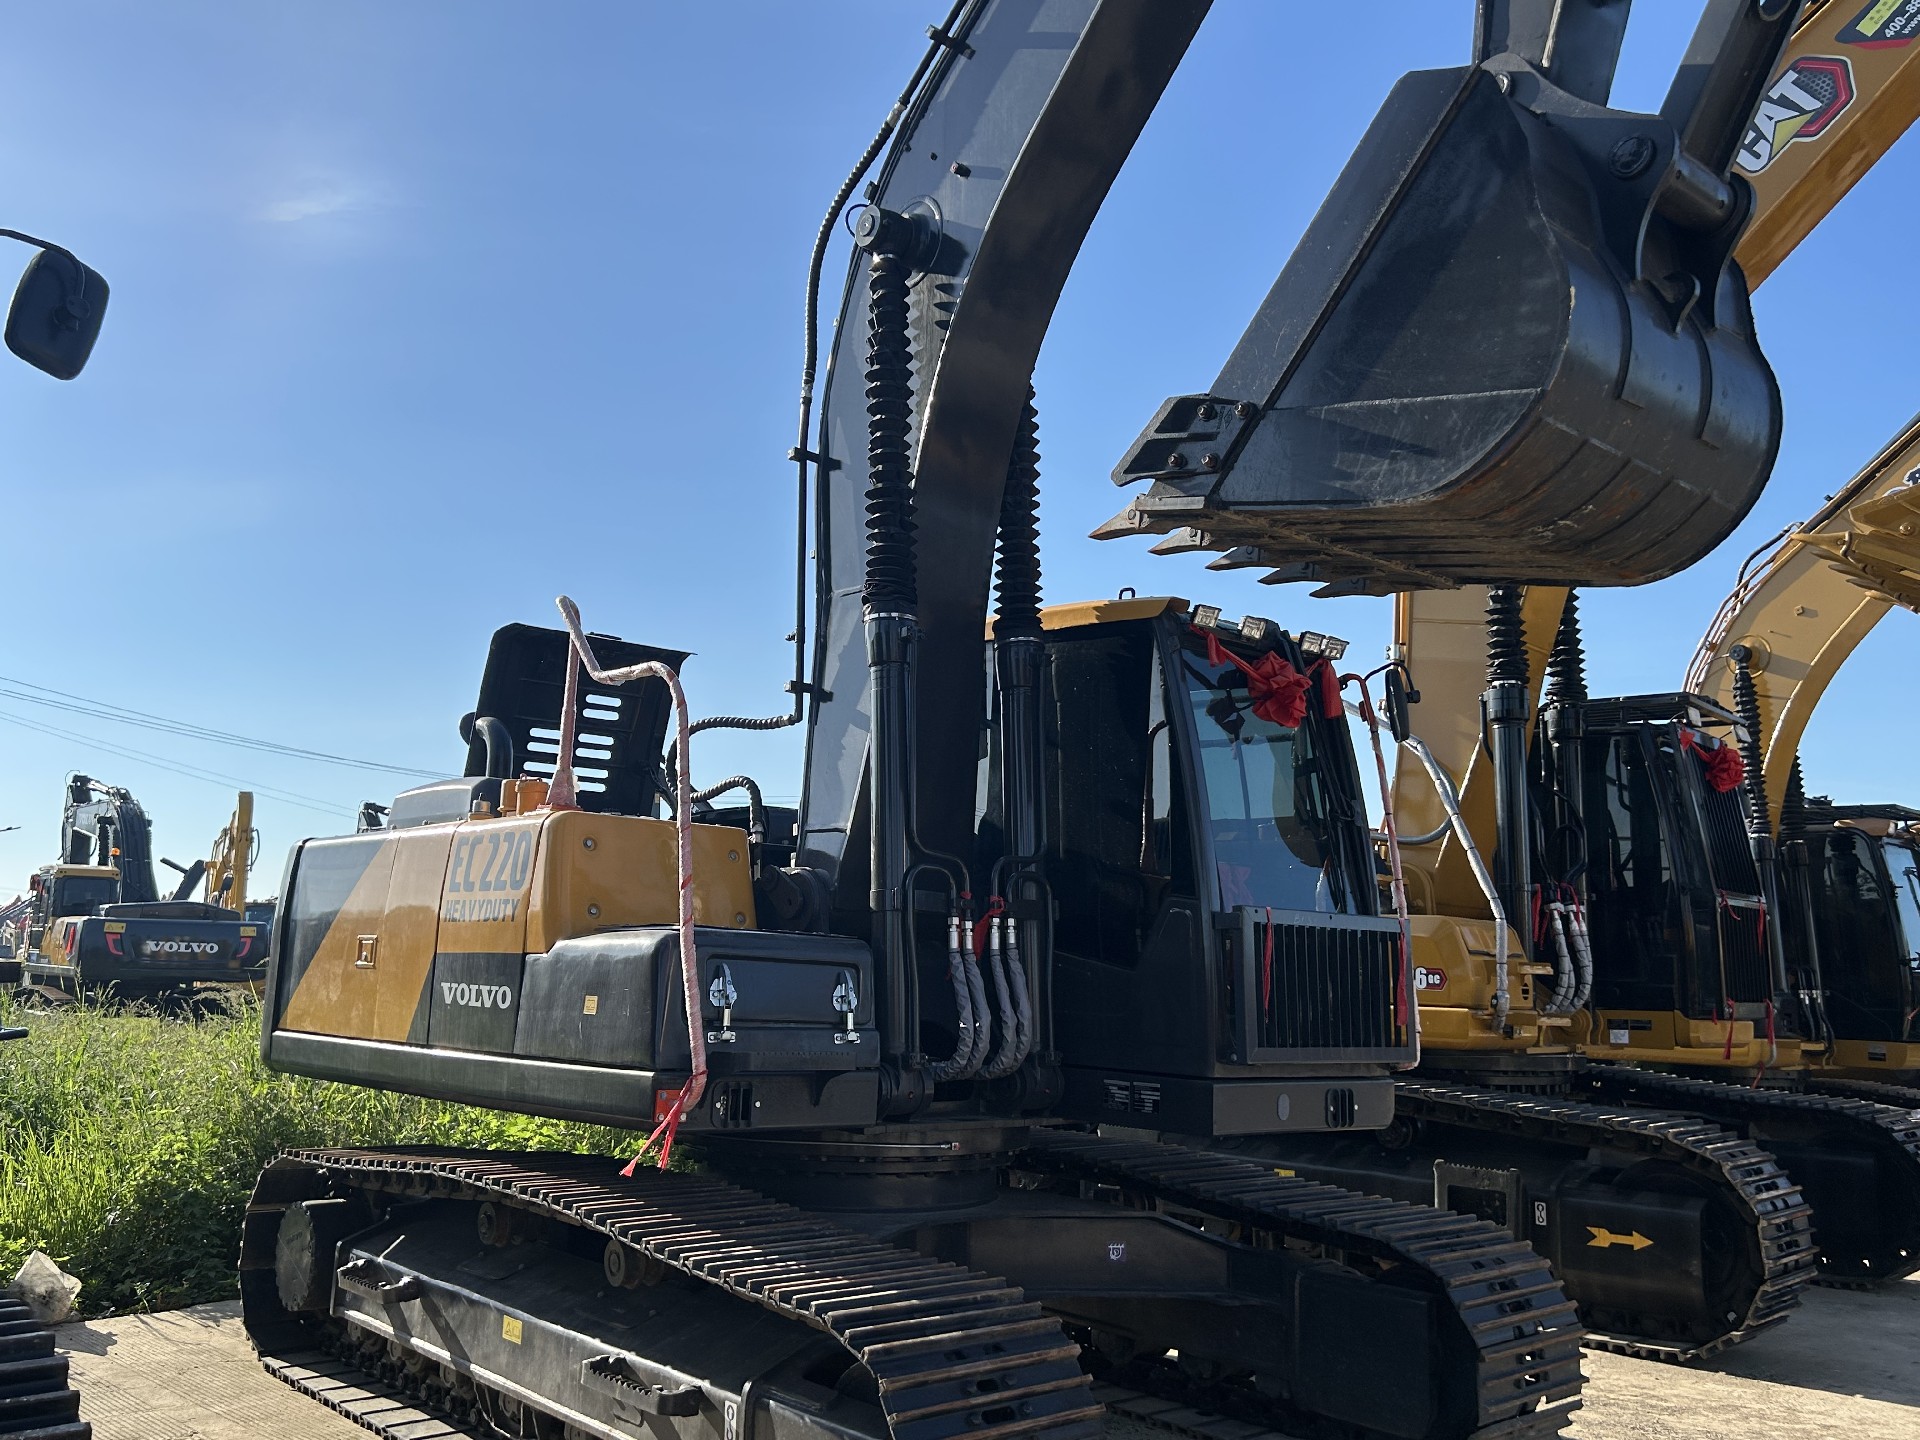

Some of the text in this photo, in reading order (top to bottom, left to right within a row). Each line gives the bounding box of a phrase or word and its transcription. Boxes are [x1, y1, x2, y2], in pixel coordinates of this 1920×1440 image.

[1736, 69, 1822, 173] CAT
[443, 898, 521, 923] HEAVYDUTY
[146, 940, 219, 954] VOLVO
[441, 981, 512, 1009] VOLVO
